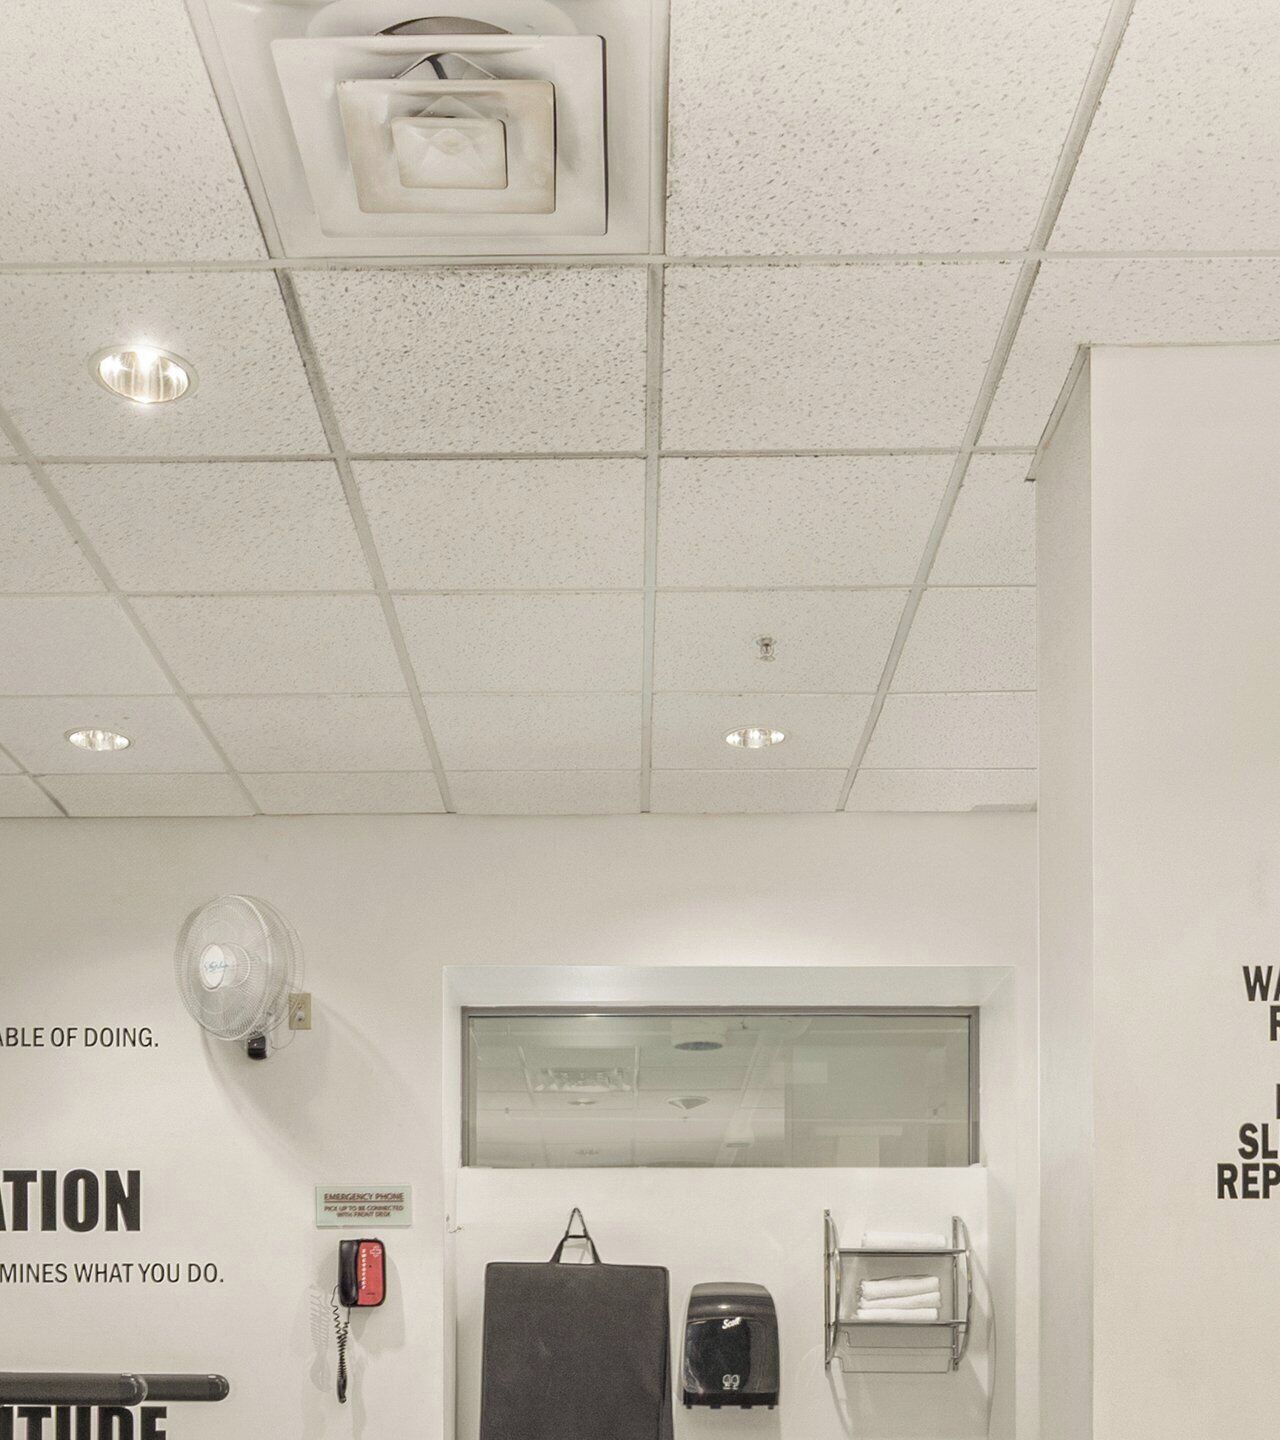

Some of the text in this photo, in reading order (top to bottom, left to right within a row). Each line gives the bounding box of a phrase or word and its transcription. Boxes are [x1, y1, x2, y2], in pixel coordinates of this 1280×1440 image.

[50, 1027, 78, 1047] OF
[84, 1027, 159, 1047] DOING.
[324, 1193, 404, 1201] EMERGENCY PHONE
[74, 1263, 134, 1283] WHAT
[138, 1263, 180, 1283] YOU
[188, 1263, 224, 1283] DO.
